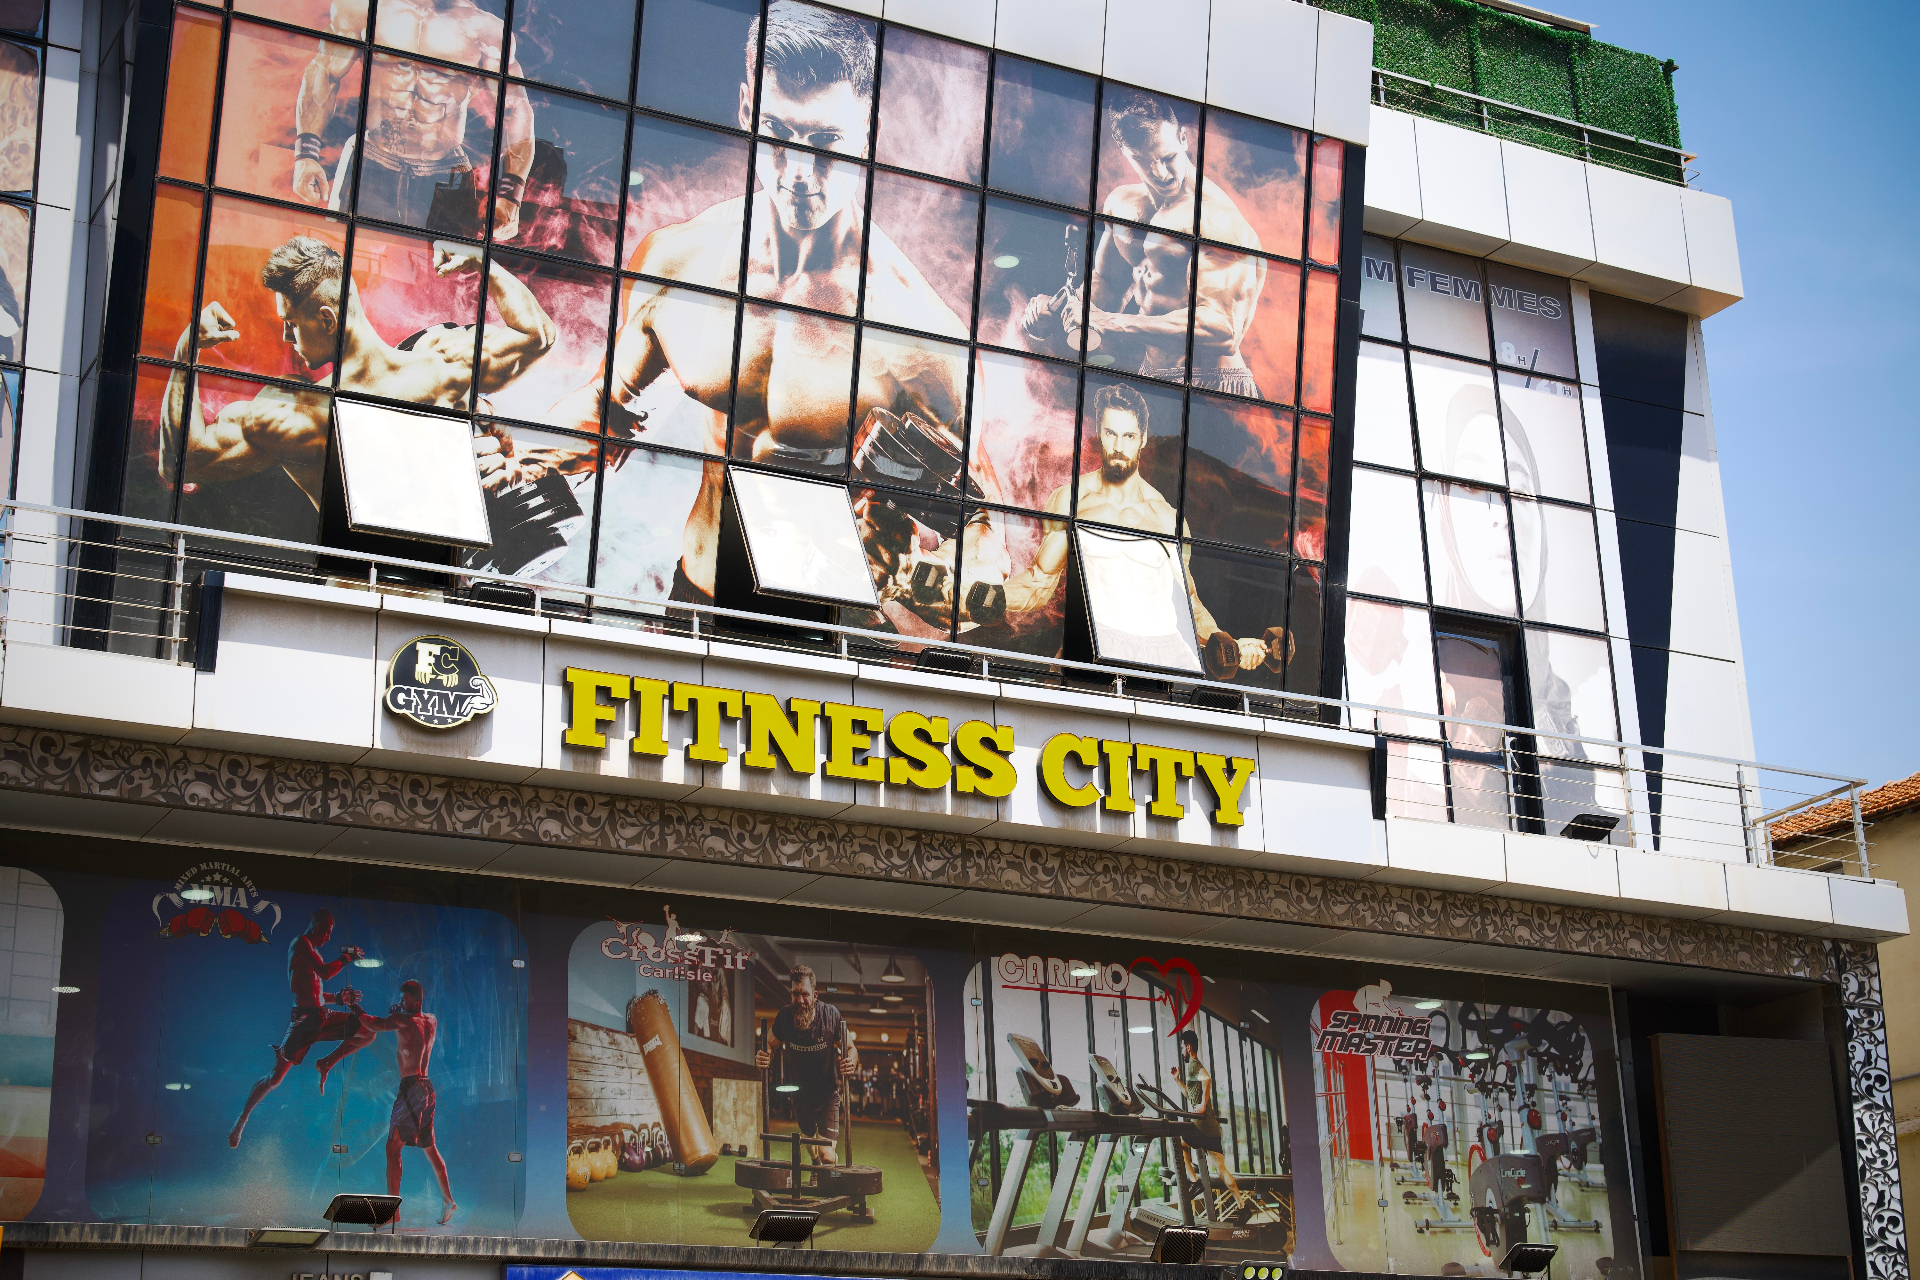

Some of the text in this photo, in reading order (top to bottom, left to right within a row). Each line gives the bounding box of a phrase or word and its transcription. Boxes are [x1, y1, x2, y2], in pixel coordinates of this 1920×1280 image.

[1405, 266, 1562, 319] FEMMES
[415, 641, 460, 676] FC
[388, 685, 470, 719] GYM
[563, 665, 1256, 828] FITNESS CITY
[174, 861, 259, 898] MIXED MARTIAL ARTS
[189, 883, 249, 909] MMA
[600, 936, 752, 970] CrossFit
[638, 963, 713, 982] Carlisle
[998, 952, 1130, 993] CARDIO
[1326, 1009, 1433, 1038] SPINNING
[1313, 1029, 1433, 1060] MASTER
